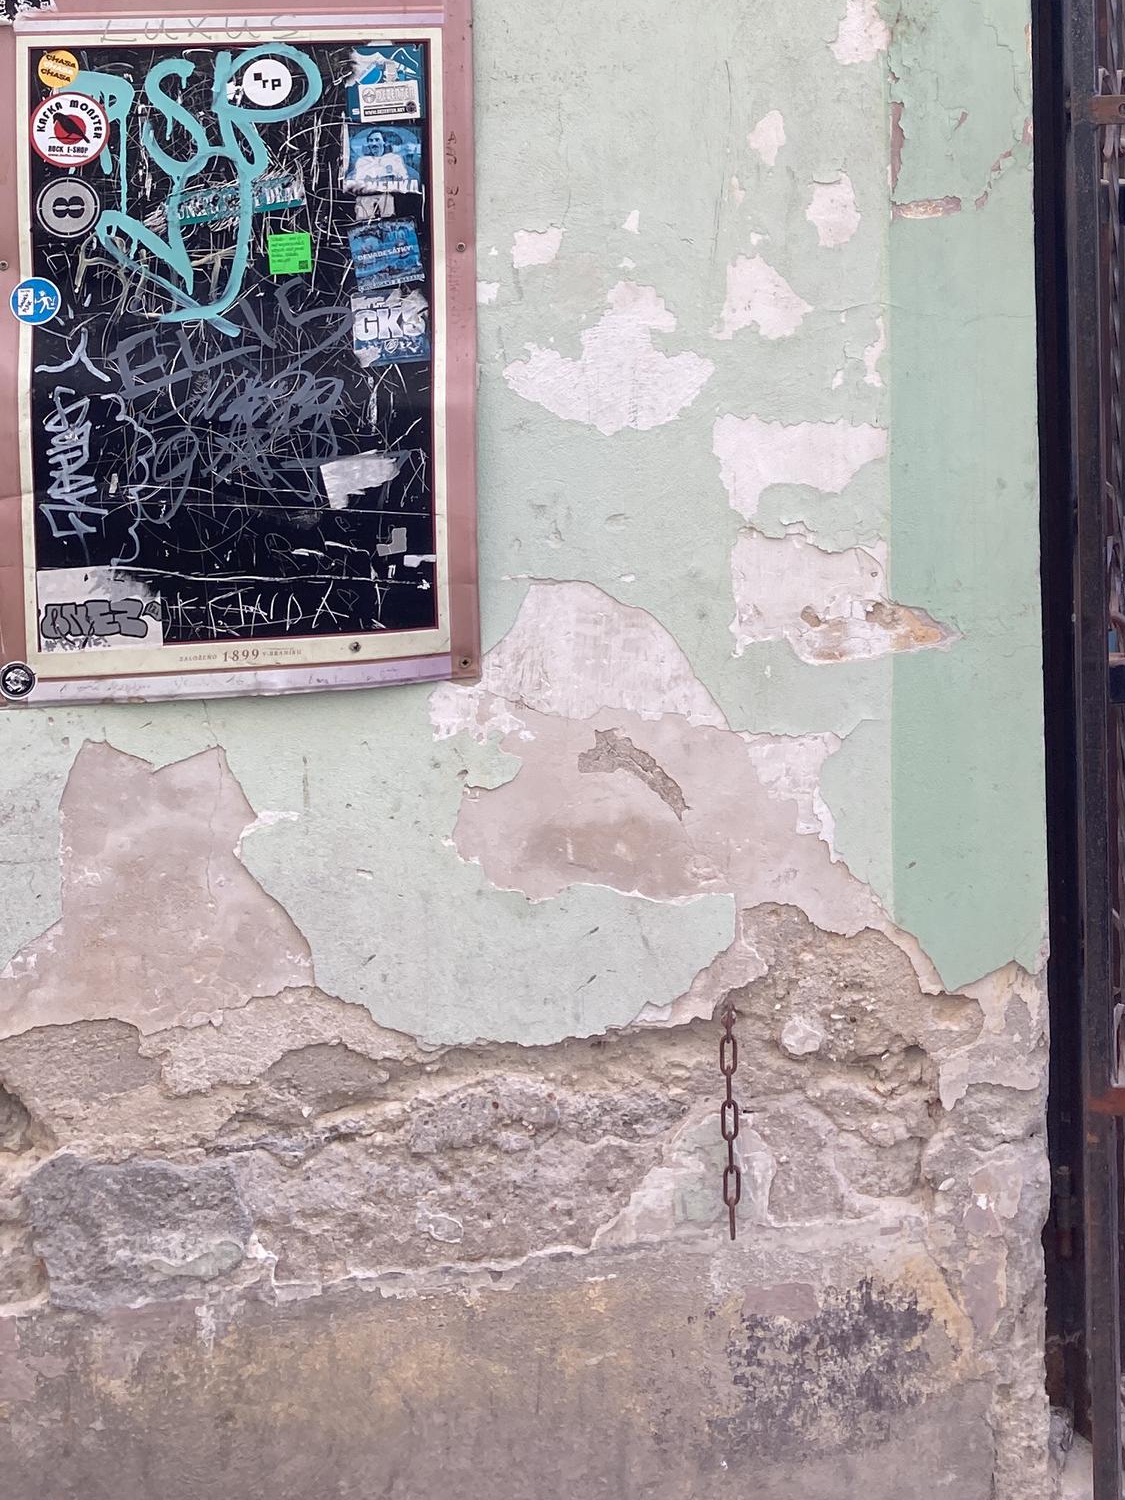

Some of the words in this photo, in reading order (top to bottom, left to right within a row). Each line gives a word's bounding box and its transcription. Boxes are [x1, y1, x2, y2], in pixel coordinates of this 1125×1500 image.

[100, 14, 308, 43] LUXUS
[69, 99, 103, 139] MONSTER
[223, 648, 260, 663] 1899
